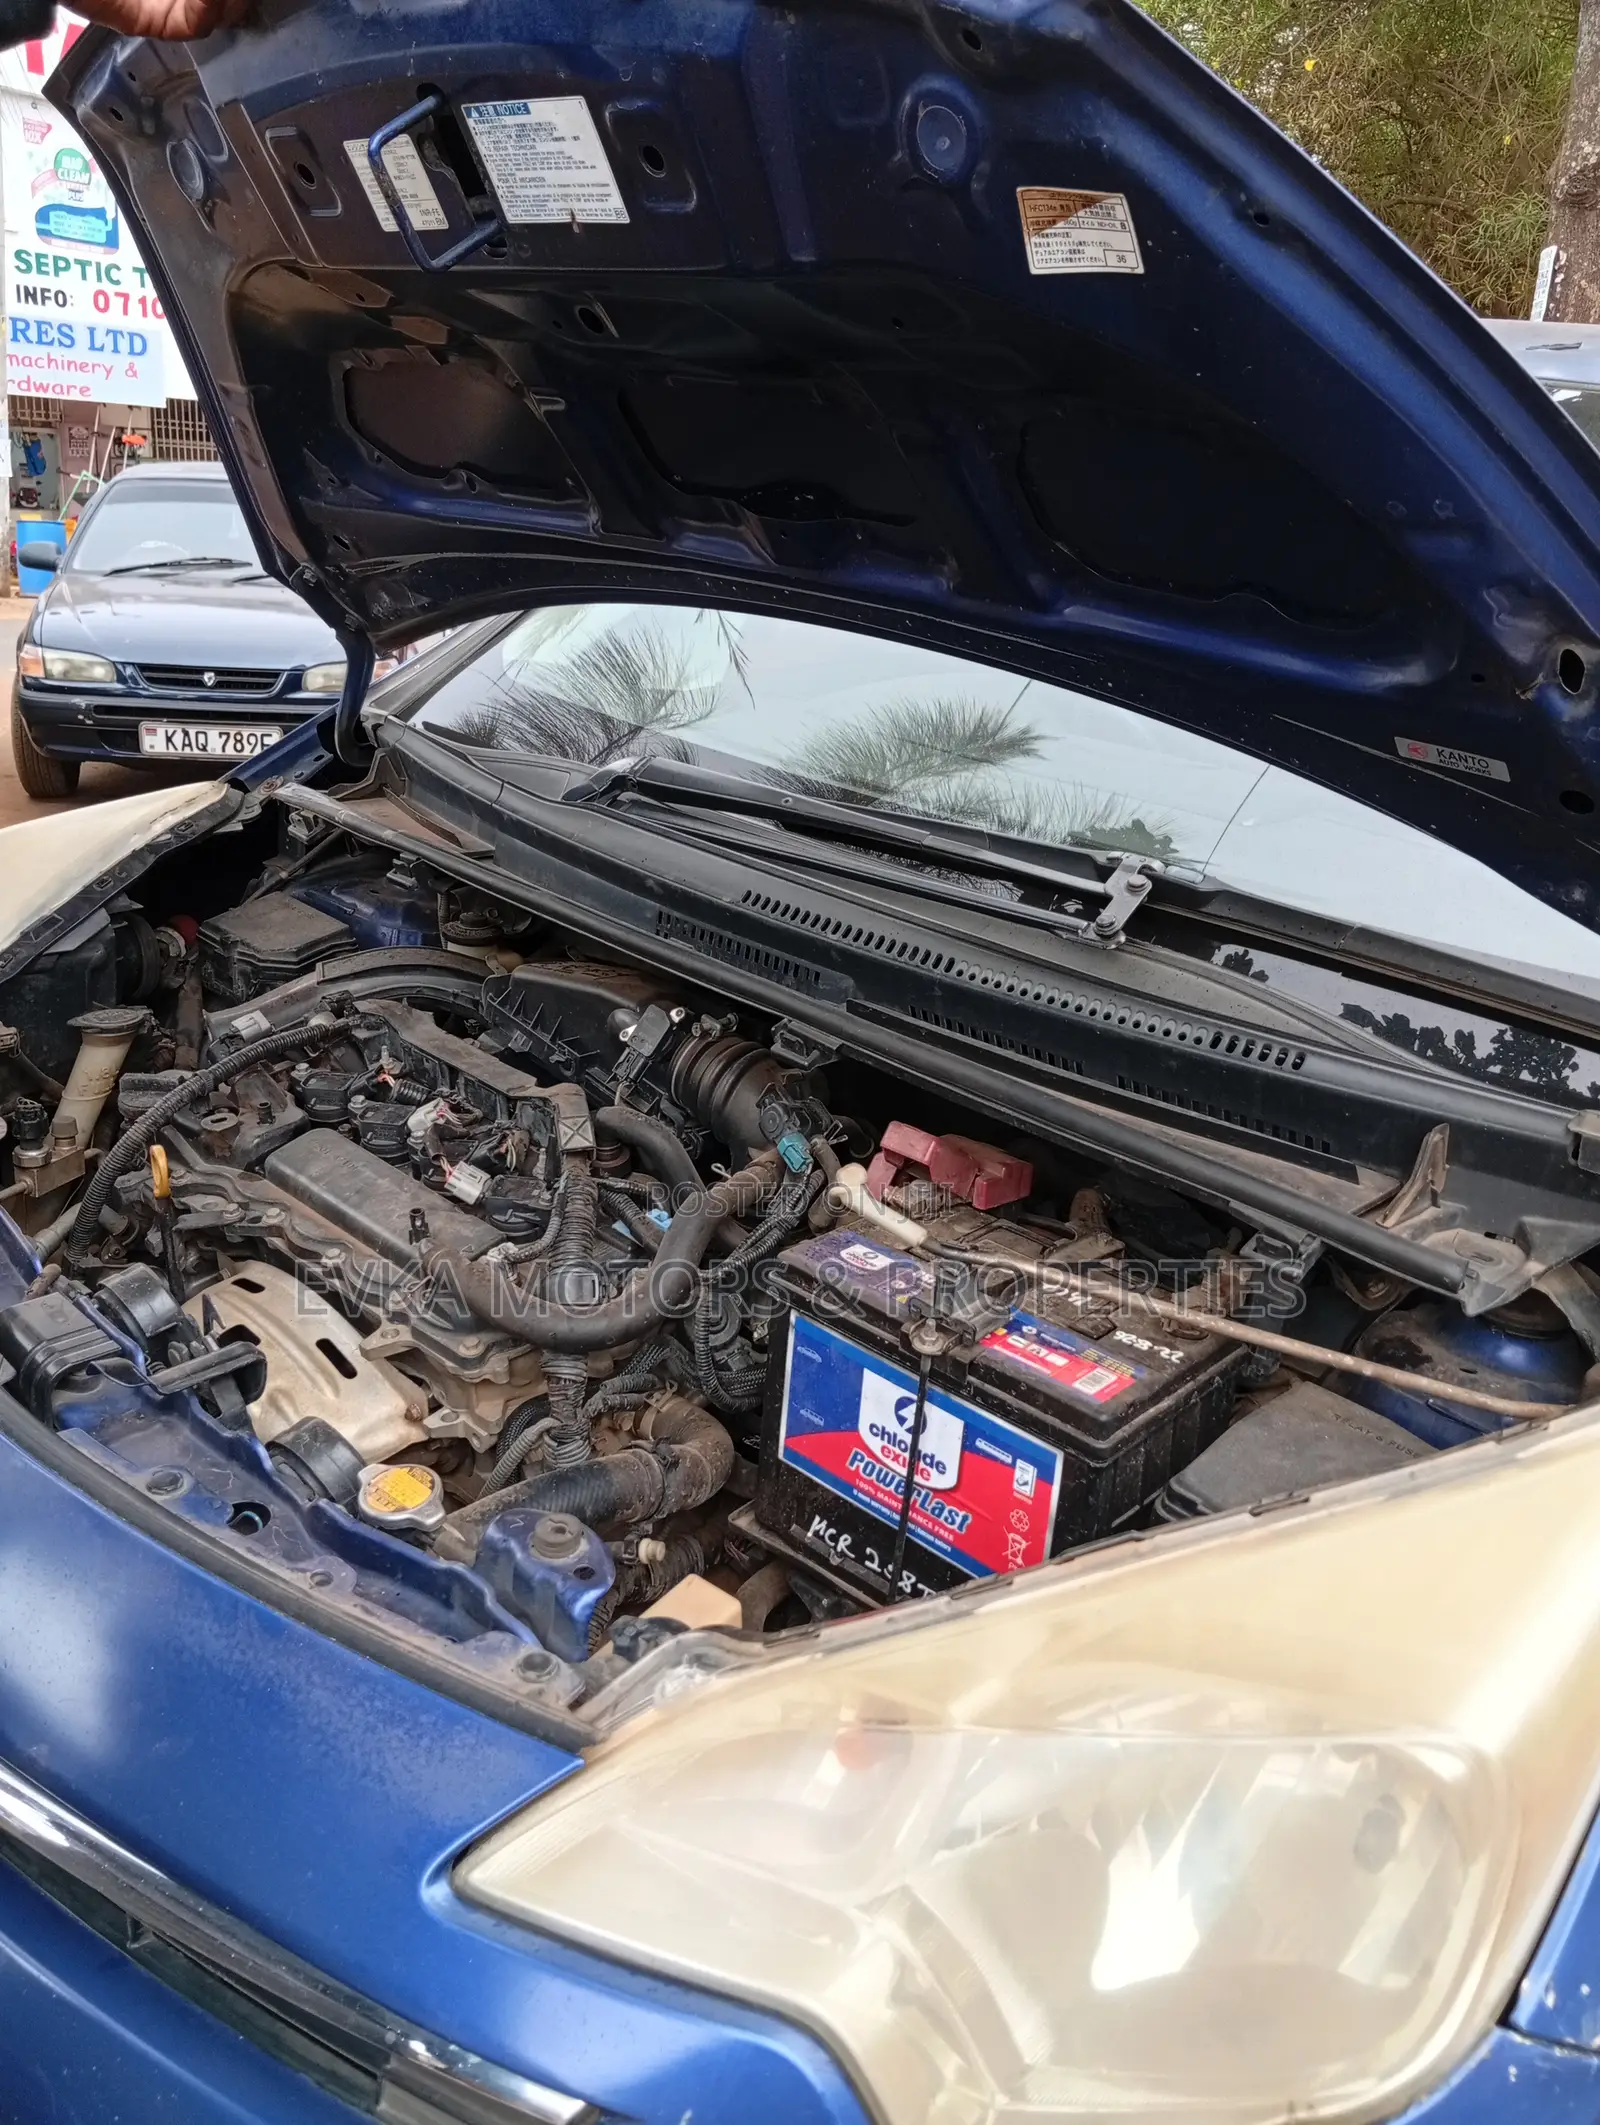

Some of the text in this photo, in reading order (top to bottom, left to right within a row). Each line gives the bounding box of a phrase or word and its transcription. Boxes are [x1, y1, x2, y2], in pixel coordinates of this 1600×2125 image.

[496, 103, 527, 115] NOTICE
[58, 168, 91, 185] CLEAN
[14, 249, 122, 286] SEPTIC
[1116, 254, 1127, 264] 36
[16, 284, 166, 319] INFO: 0710
[9, 317, 148, 356] RES LTD
[6, 352, 138, 380] machinery &
[7, 375, 92, 397] rdware
[165, 728, 209, 752] KAQ
[1436, 748, 1490, 769] KANTO
[1438, 759, 1492, 776] AUTO WORKS
[869, 1422, 947, 1476] chloide
[856, 1478, 876, 1495] 100%
[934, 1525, 955, 1542] FREE
